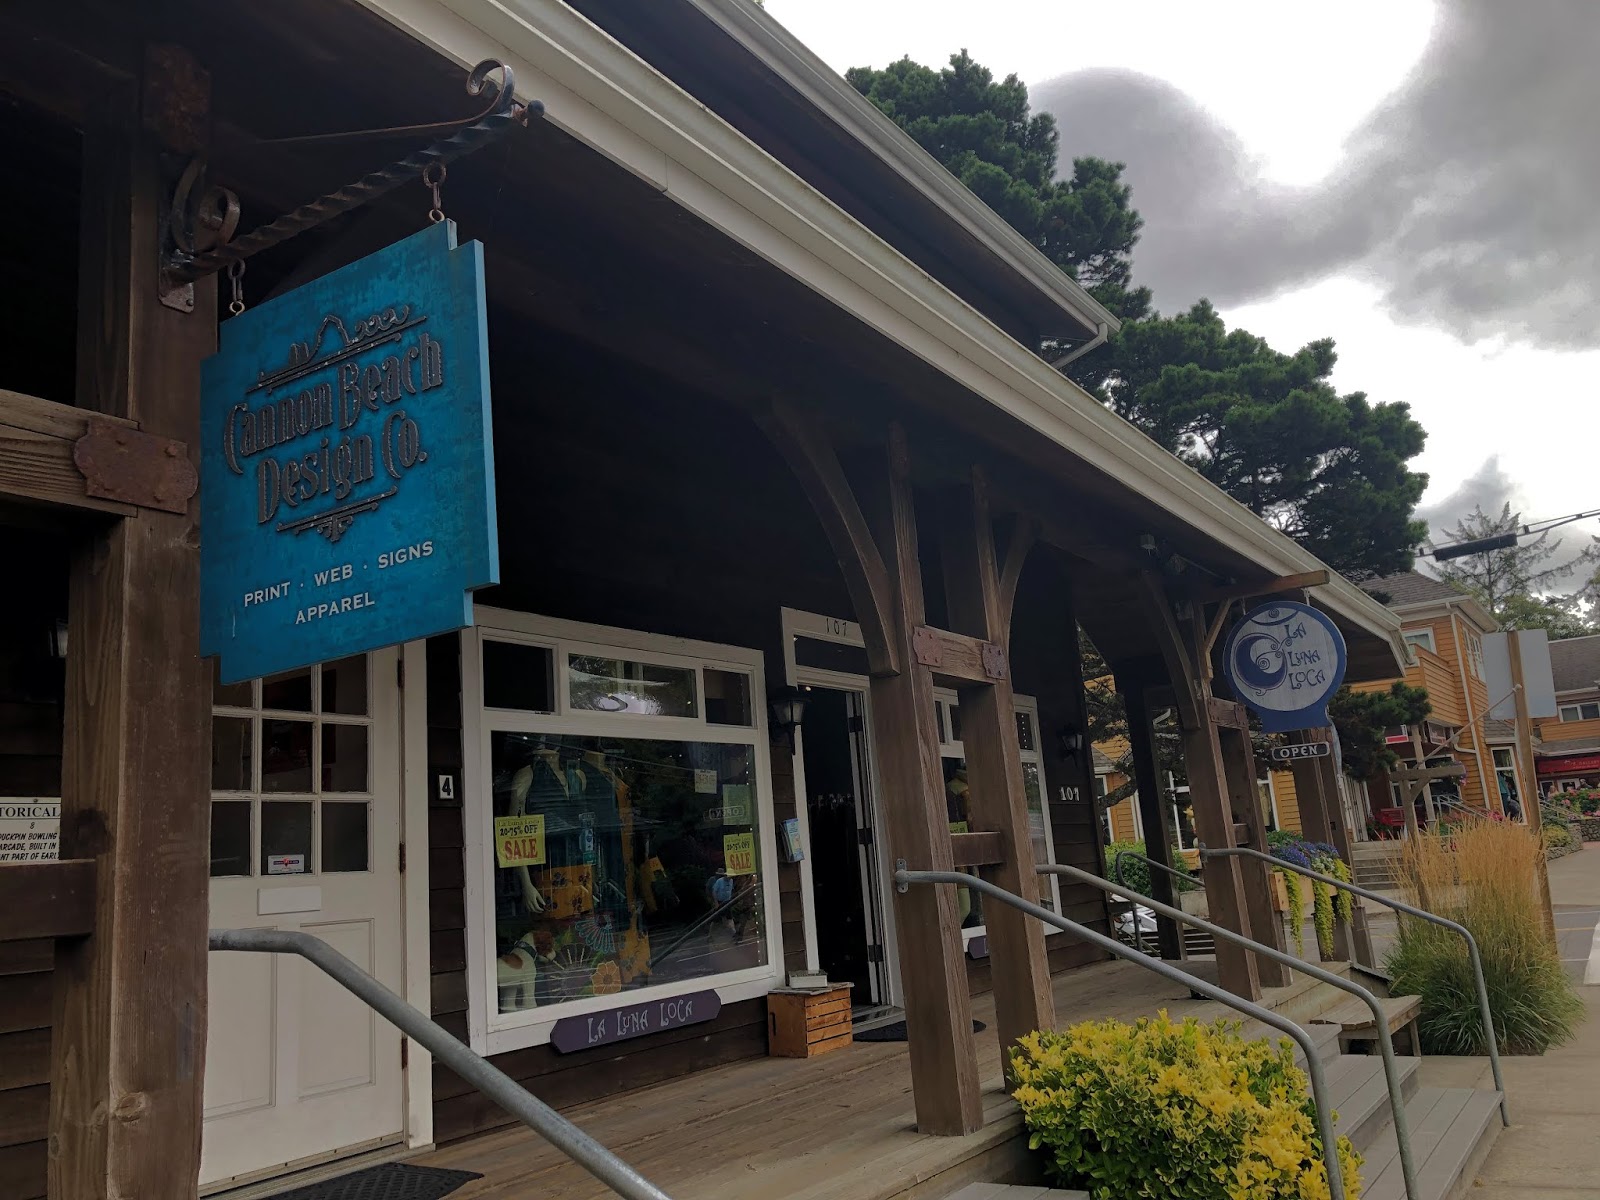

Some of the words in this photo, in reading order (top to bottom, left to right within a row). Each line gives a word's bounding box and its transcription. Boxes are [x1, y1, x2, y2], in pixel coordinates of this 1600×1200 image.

[223, 381, 334, 475] Cannon
[336, 333, 443, 430] Beach
[258, 433, 374, 525] Design
[381, 410, 428, 479] Co.
[244, 582, 291, 607] PRINT
[314, 564, 354, 587] WEB
[377, 541, 434, 569] SIGNS
[295, 591, 375, 625] APPAREL
[1284, 622, 1307, 639] LA
[1288, 650, 1321, 667] LUNA
[1288, 669, 1326, 690] LOCA
[1279, 745, 1318, 759] OPEN
[441, 776, 452, 797] 4
[524, 824, 538, 834] OFF
[11, 852, 29, 861] PART
[30, 852, 40, 860] OF
[505, 838, 537, 860] SALE
[729, 852, 752, 870] SALE
[587, 1017, 606, 1044] LA
[616, 1009, 649, 1037] LUNA
[660, 999, 693, 1027] LOCA
